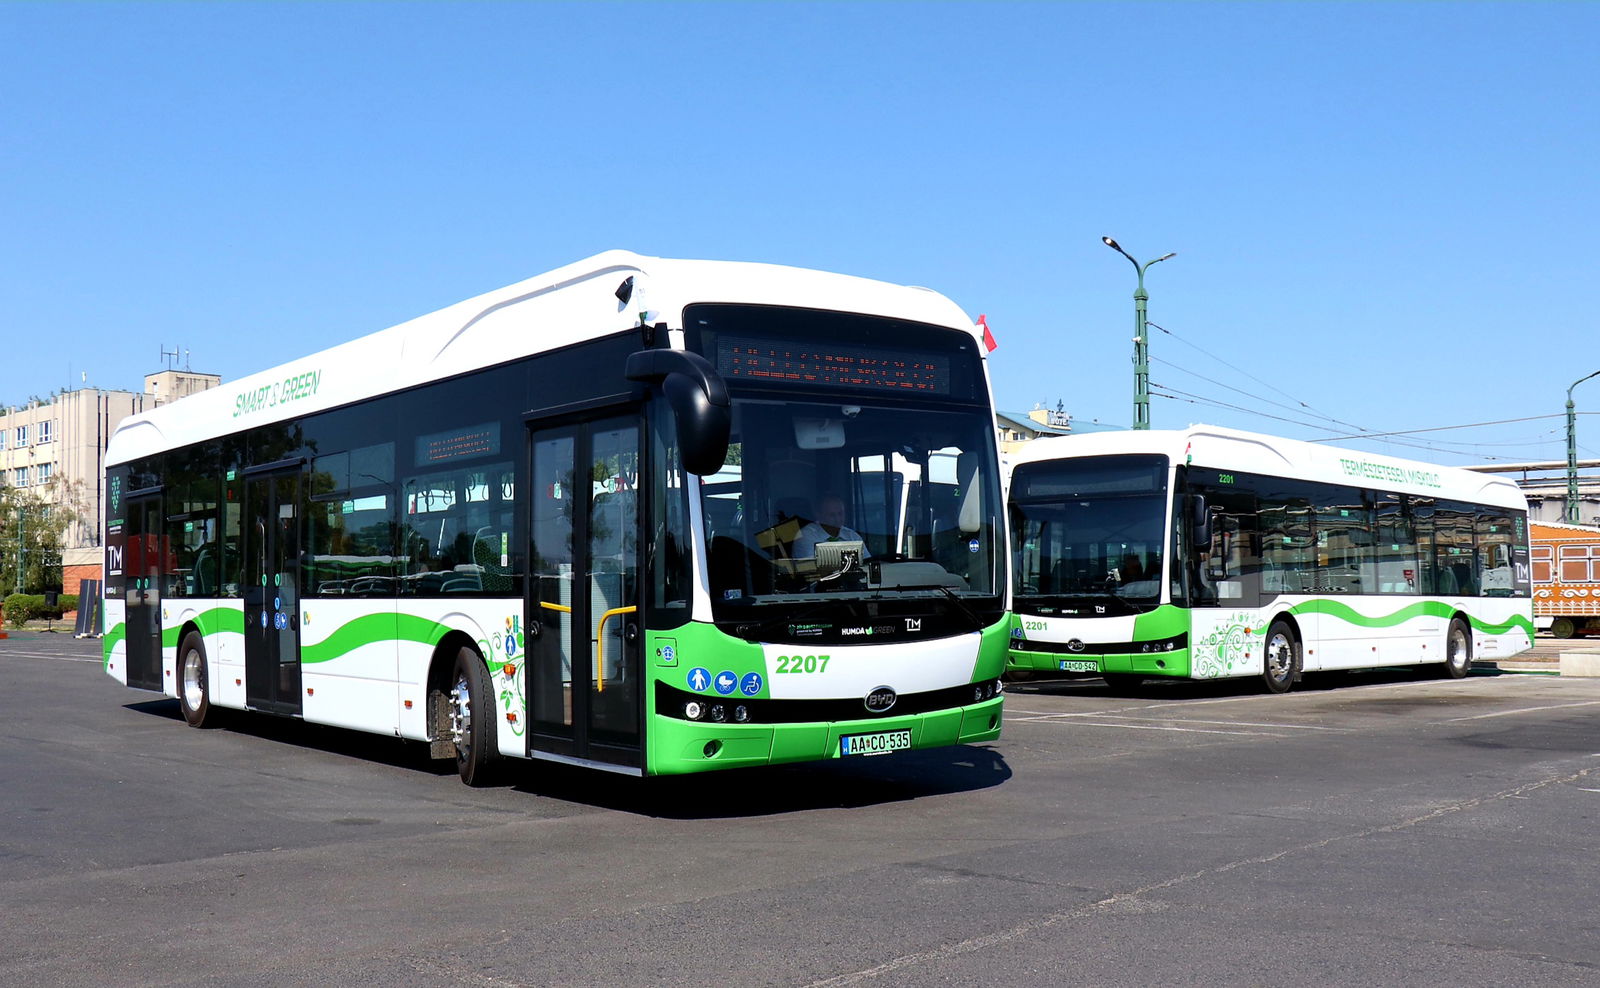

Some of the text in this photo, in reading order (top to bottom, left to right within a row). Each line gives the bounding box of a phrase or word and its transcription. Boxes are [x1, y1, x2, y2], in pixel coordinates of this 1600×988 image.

[233, 385, 271, 418] SMART
[280, 369, 321, 404] GREEN
[1219, 473, 1234, 484] 2201
[905, 618, 921, 631] TM
[1025, 621, 1048, 631] 2201
[775, 655, 831, 674] 2207
[868, 693, 894, 706] BYD
